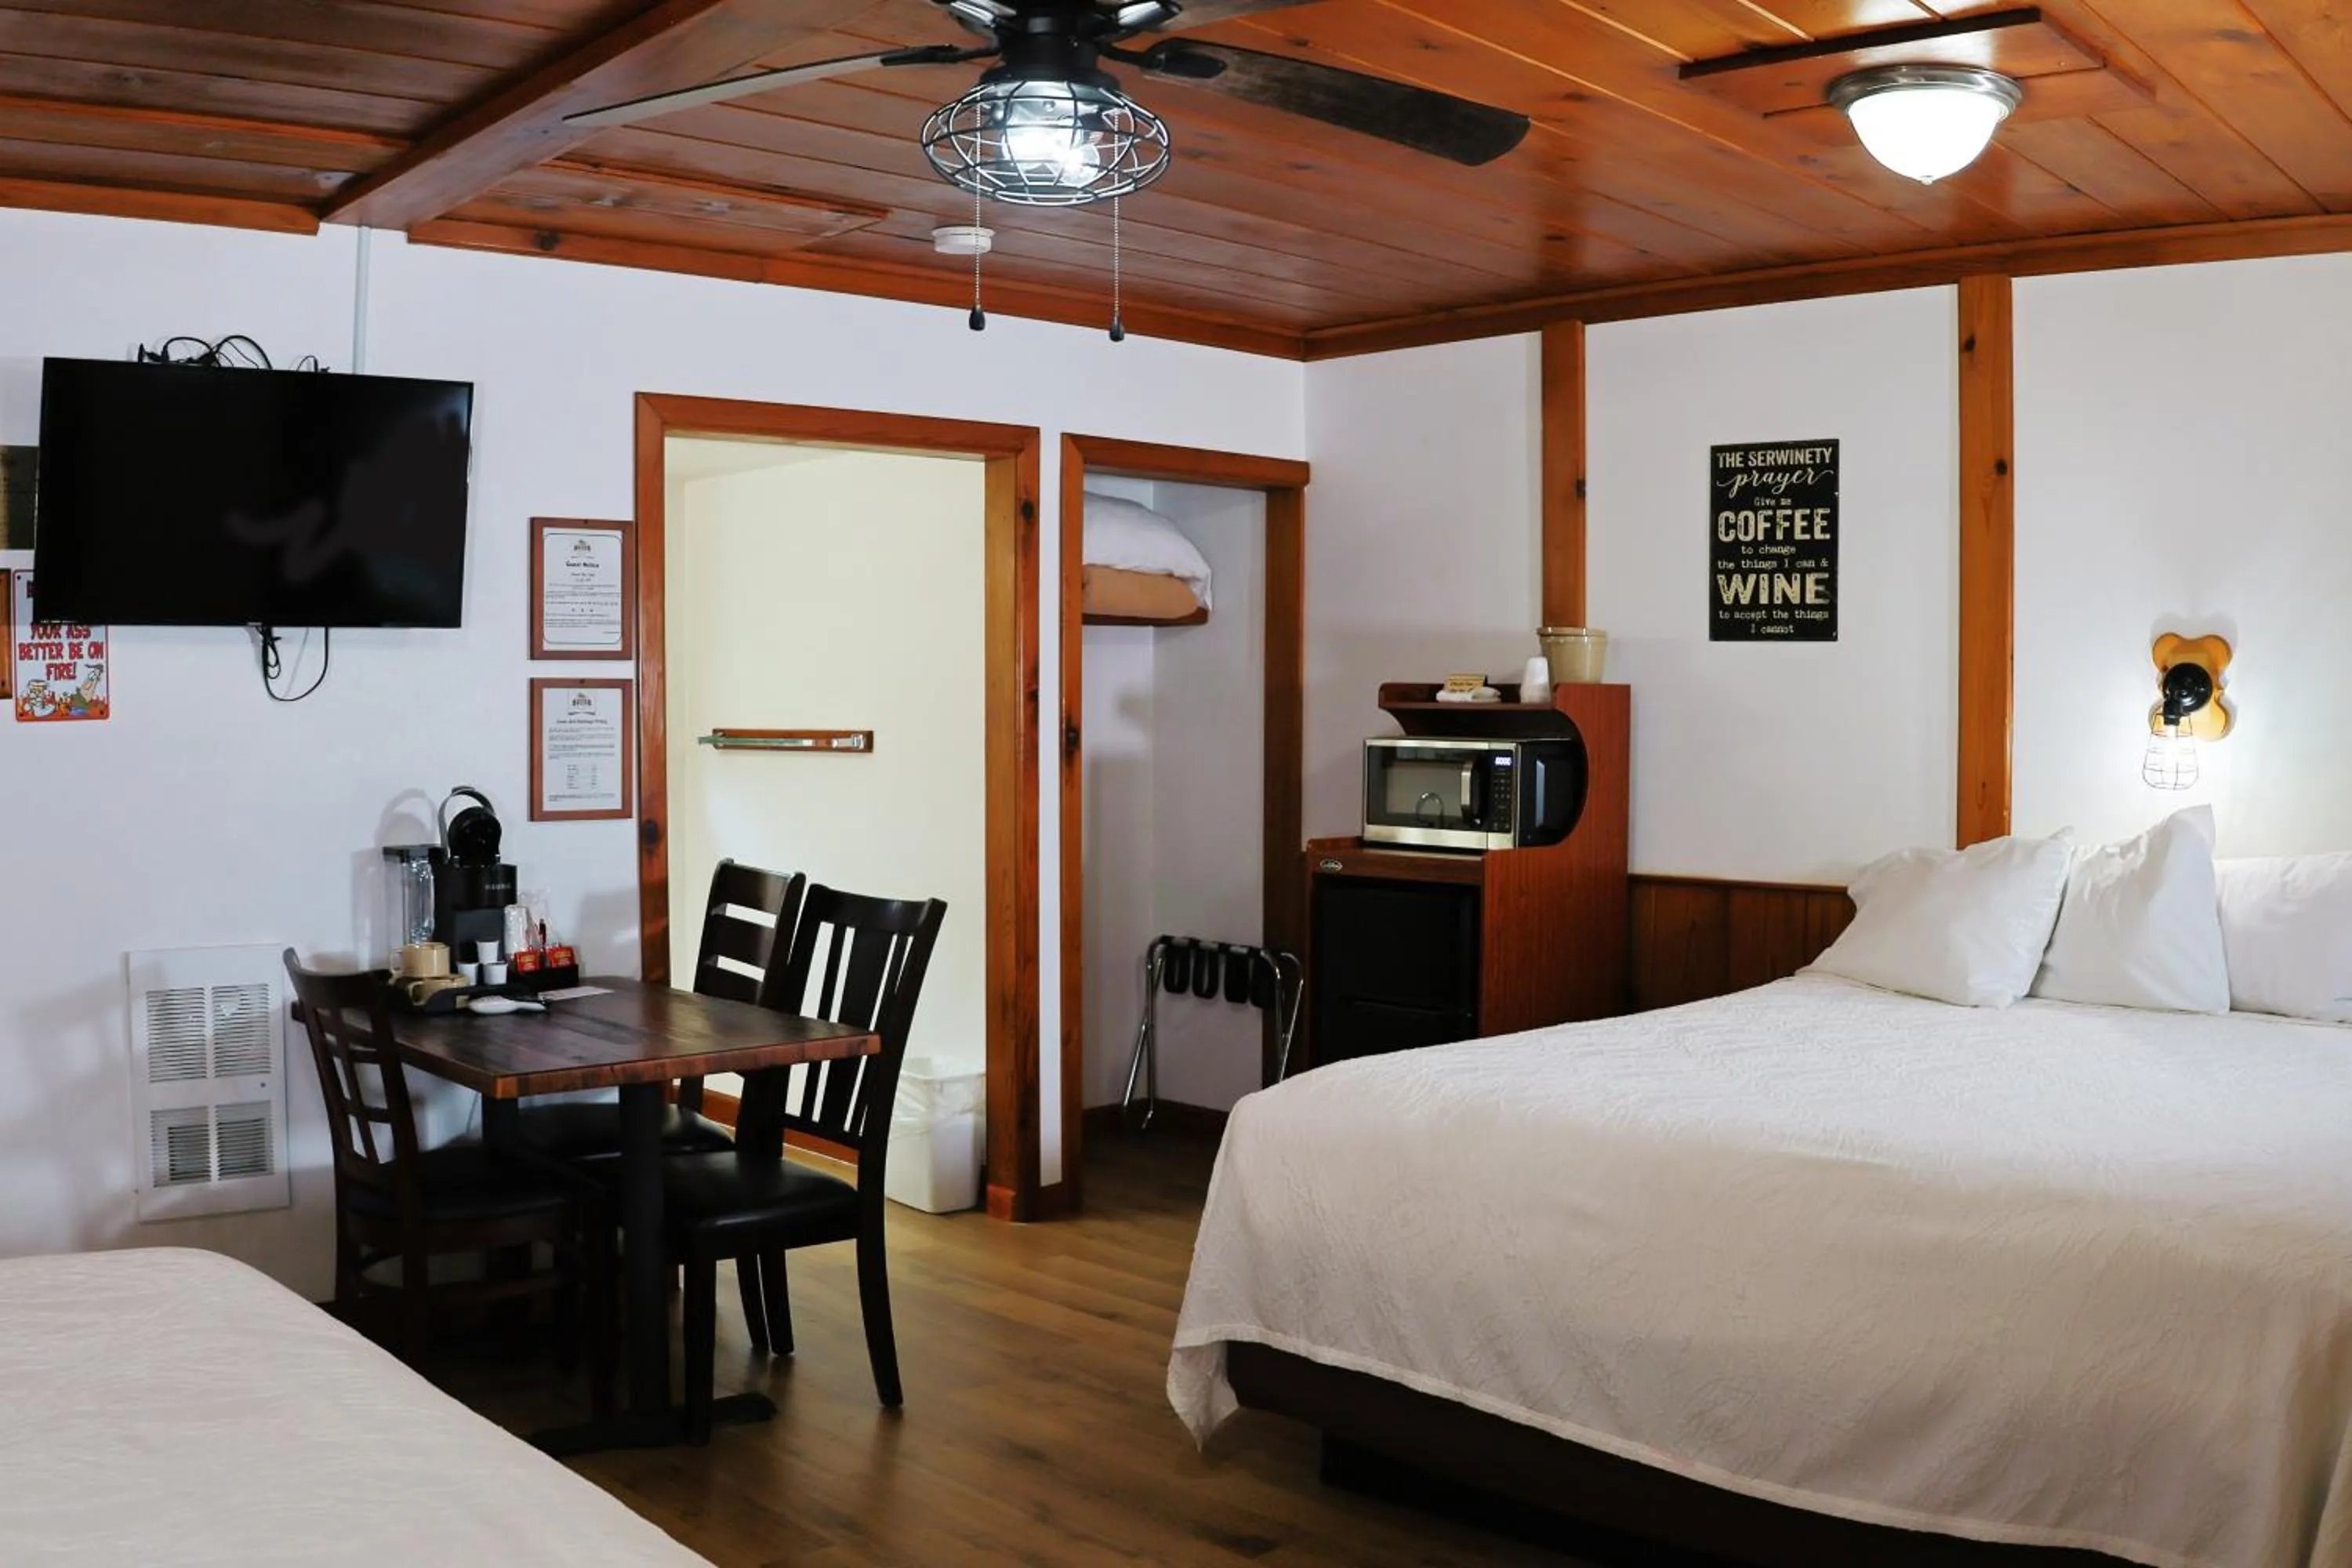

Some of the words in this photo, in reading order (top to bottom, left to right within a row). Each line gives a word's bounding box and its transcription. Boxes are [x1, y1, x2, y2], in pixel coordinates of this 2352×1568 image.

[1716, 451, 1744, 468] THE
[1748, 447, 1832, 467] SERWINETY
[1716, 468, 1834, 499] prayer
[1754, 497, 1776, 506] Give
[1718, 508, 1831, 542] COFFEE
[1740, 546, 1754, 554] to
[1759, 545, 1796, 555] change
[1718, 560, 1735, 569] the
[1741, 559, 1777, 569] things
[1784, 559, 1789, 568] I
[1796, 559, 1815, 568] can
[1820, 558, 1828, 567] &
[1716, 572, 1830, 604] WINE
[1719, 610, 1730, 619] to
[1734, 610, 1767, 621] accept
[1773, 609, 1789, 619] the
[1795, 609, 1829, 621] things
[31, 622, 62, 640] YOUR
[66, 625, 91, 639] ASS
[1760, 624, 1795, 633] cannot
[18, 641, 63, 660] BETTER
[68, 641, 84, 660] BE
[88, 641, 103, 659] ON
[45, 662, 77, 681] FIRE!
